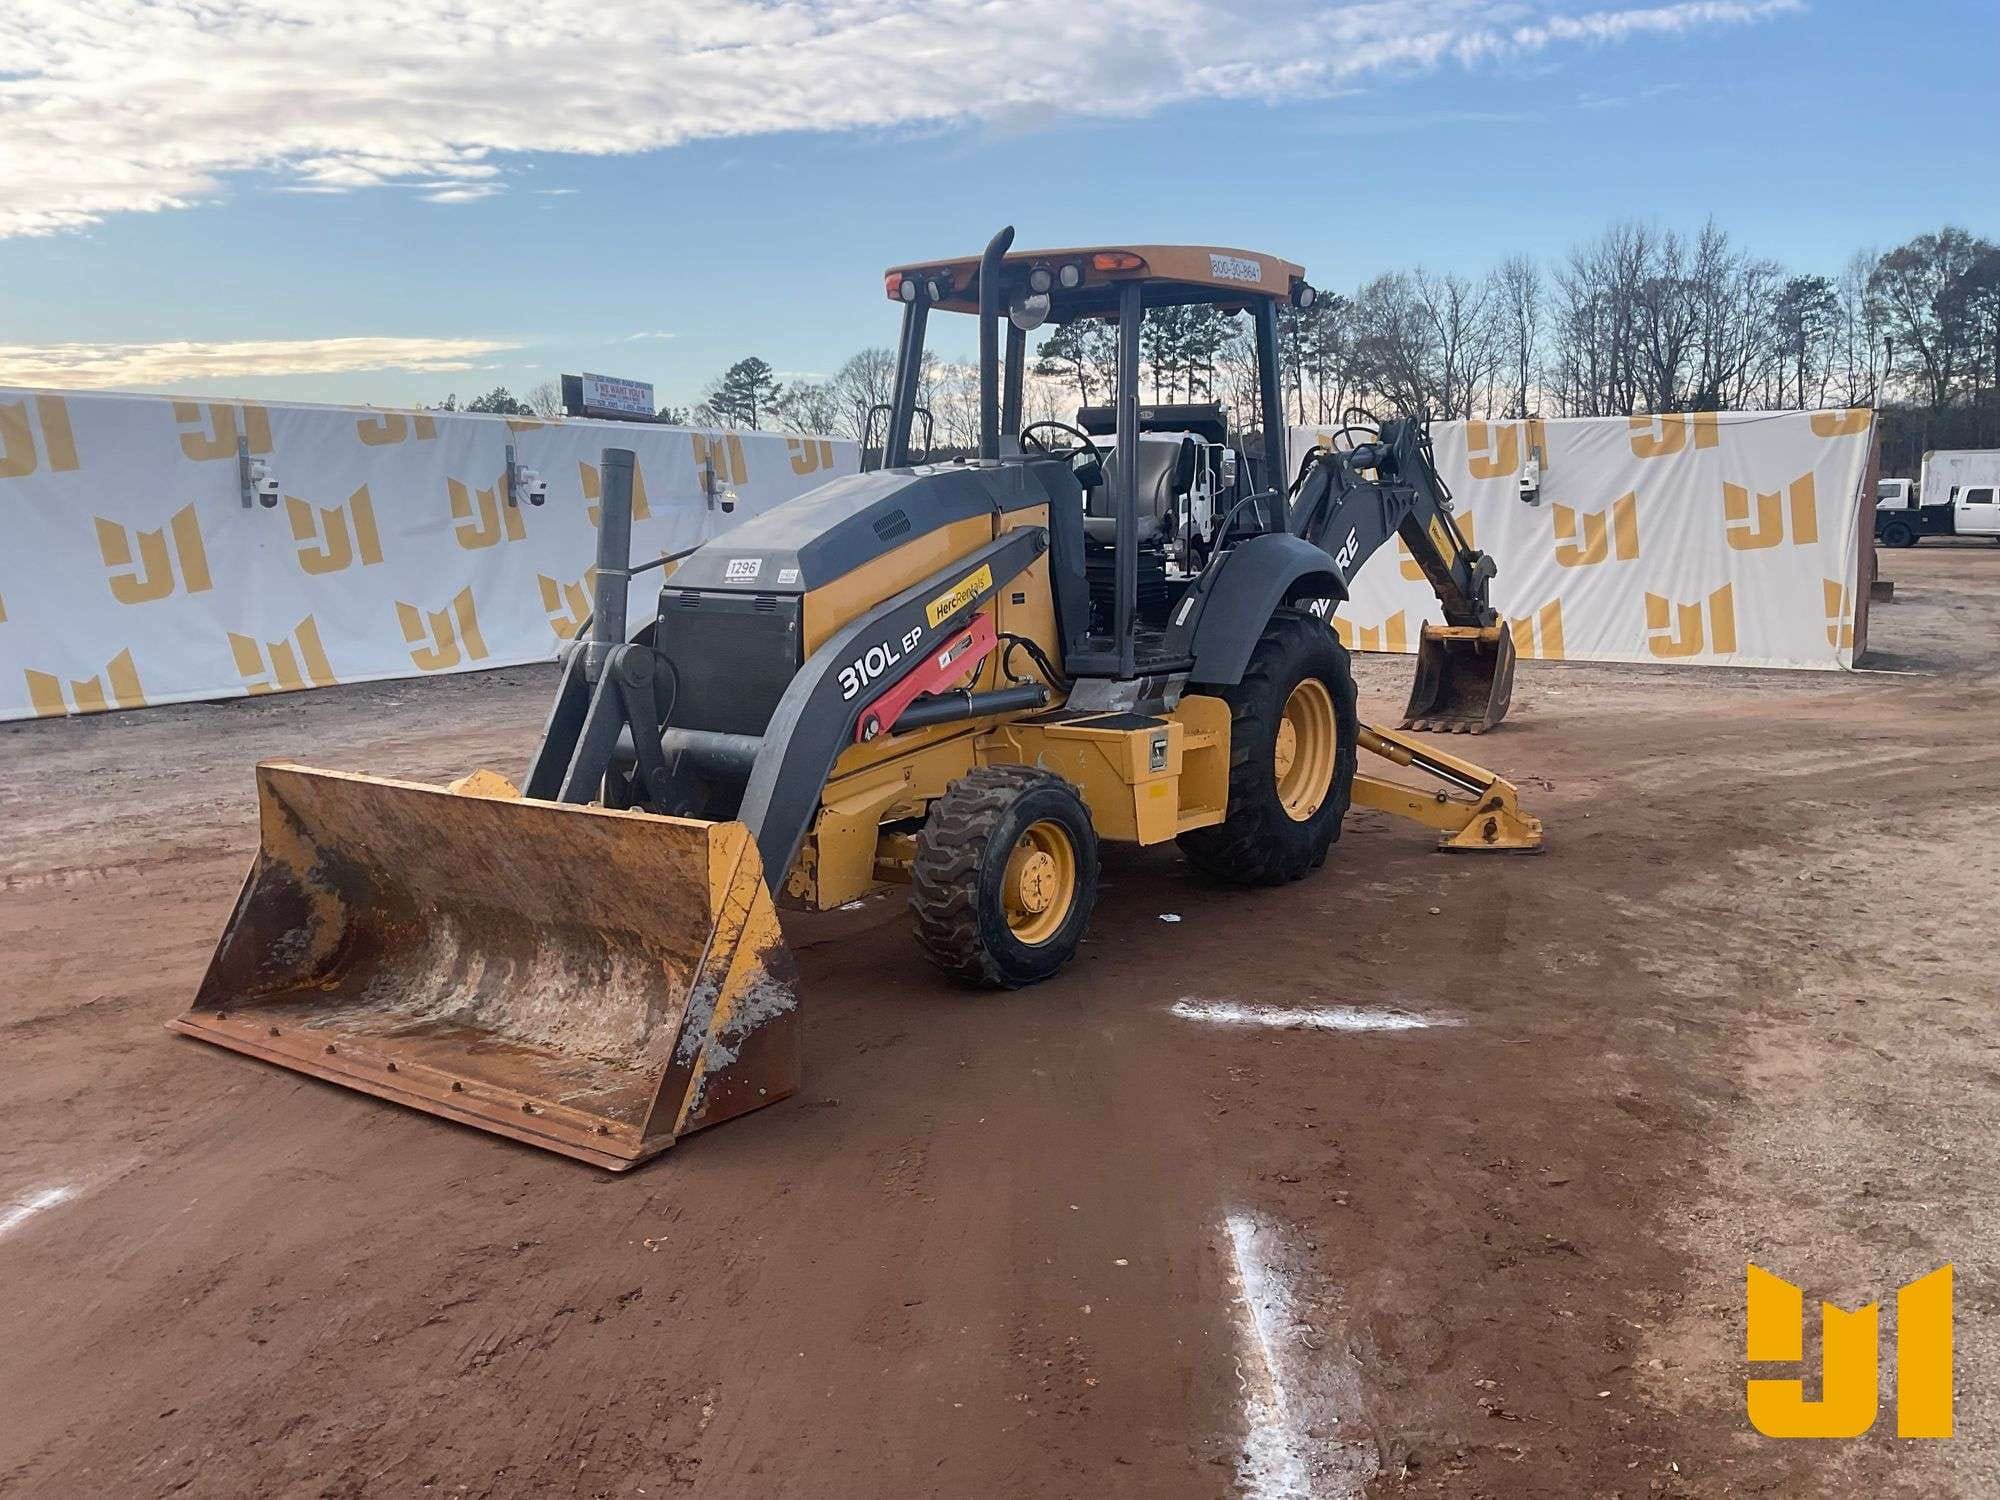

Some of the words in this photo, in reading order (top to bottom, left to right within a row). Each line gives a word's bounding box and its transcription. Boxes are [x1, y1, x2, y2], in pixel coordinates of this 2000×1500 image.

[731, 561, 757, 575] 1296
[837, 640, 900, 701] 310L
[901, 625, 923, 655] EP
